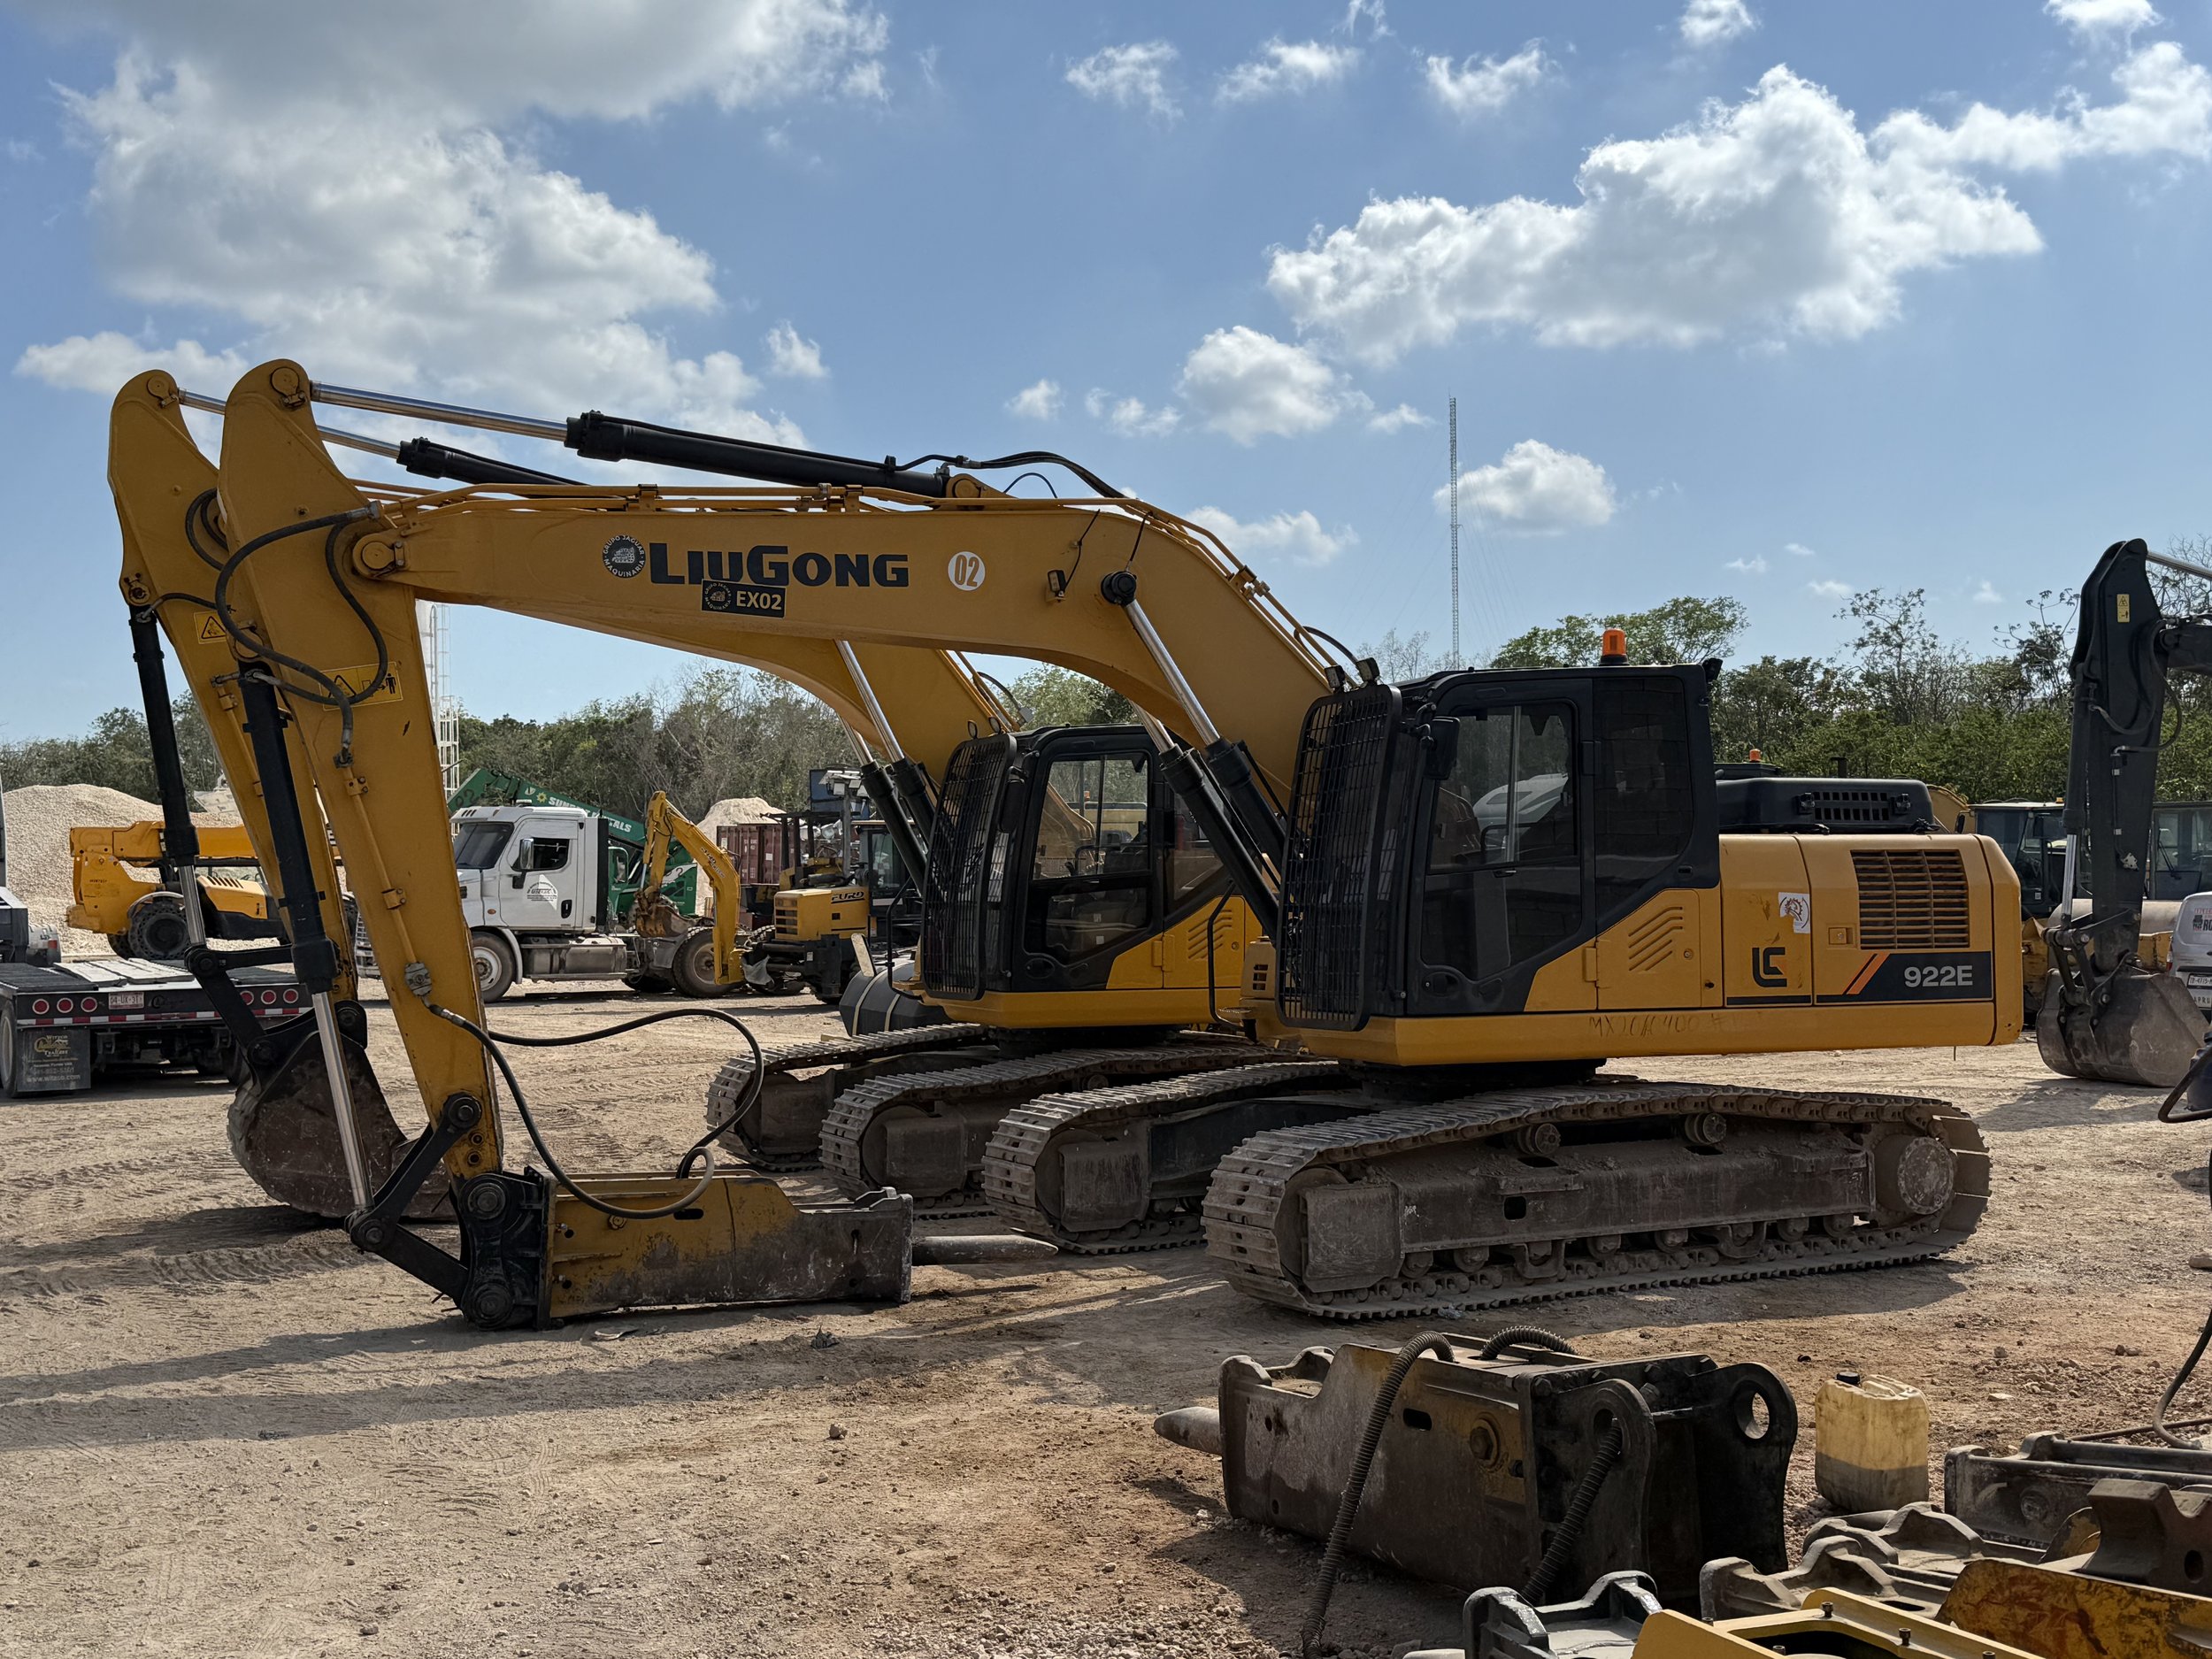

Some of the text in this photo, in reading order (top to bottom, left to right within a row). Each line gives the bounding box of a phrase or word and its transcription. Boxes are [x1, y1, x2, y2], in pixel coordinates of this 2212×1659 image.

[603, 535, 645, 555] GRUPO JAGUAR
[603, 558, 645, 577] MAQUINARIA
[955, 555, 979, 587] 02
[736, 590, 782, 611] EX02
[549, 796, 590, 816] SUNT
[1904, 964, 1973, 987] 922E
